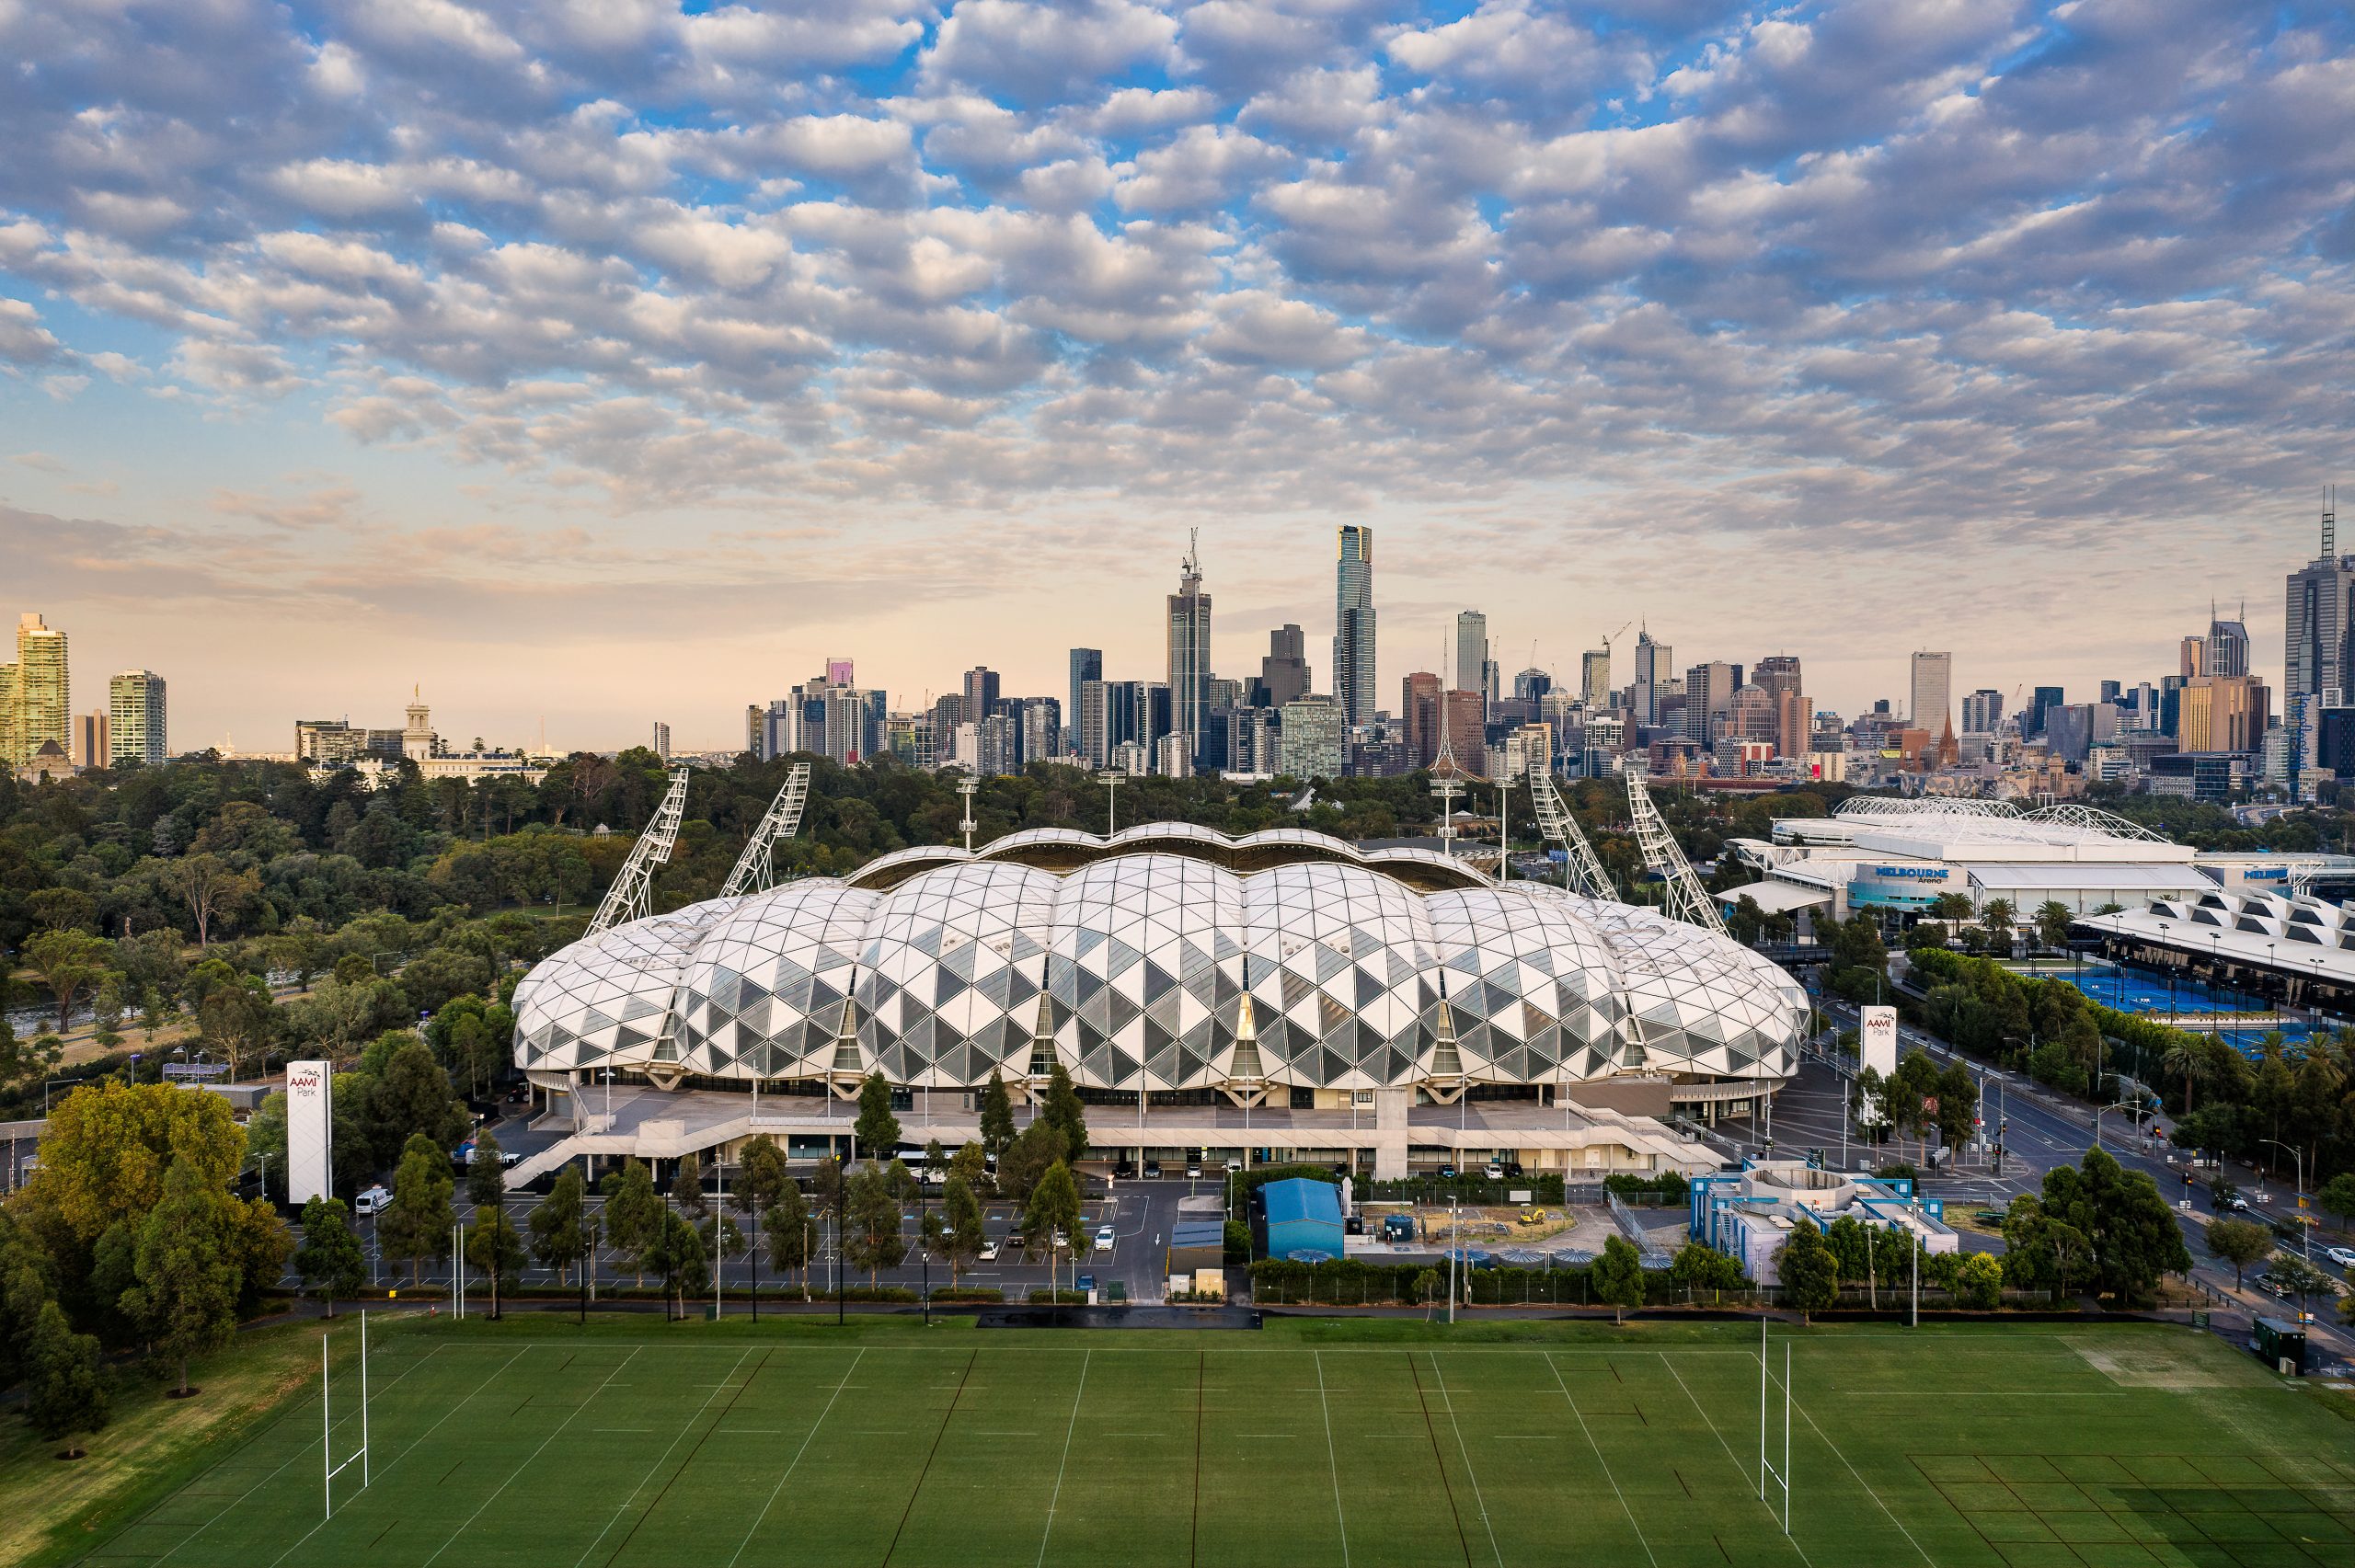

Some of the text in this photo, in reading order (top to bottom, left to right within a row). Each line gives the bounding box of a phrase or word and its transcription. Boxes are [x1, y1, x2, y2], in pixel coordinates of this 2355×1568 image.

[1876, 867, 1948, 878] MELBOURNE
[1867, 1019, 1890, 1027] AAMI
[1873, 1027, 1890, 1036] Park
[290, 1077, 316, 1087] AAMI
[297, 1087, 316, 1096] Park
